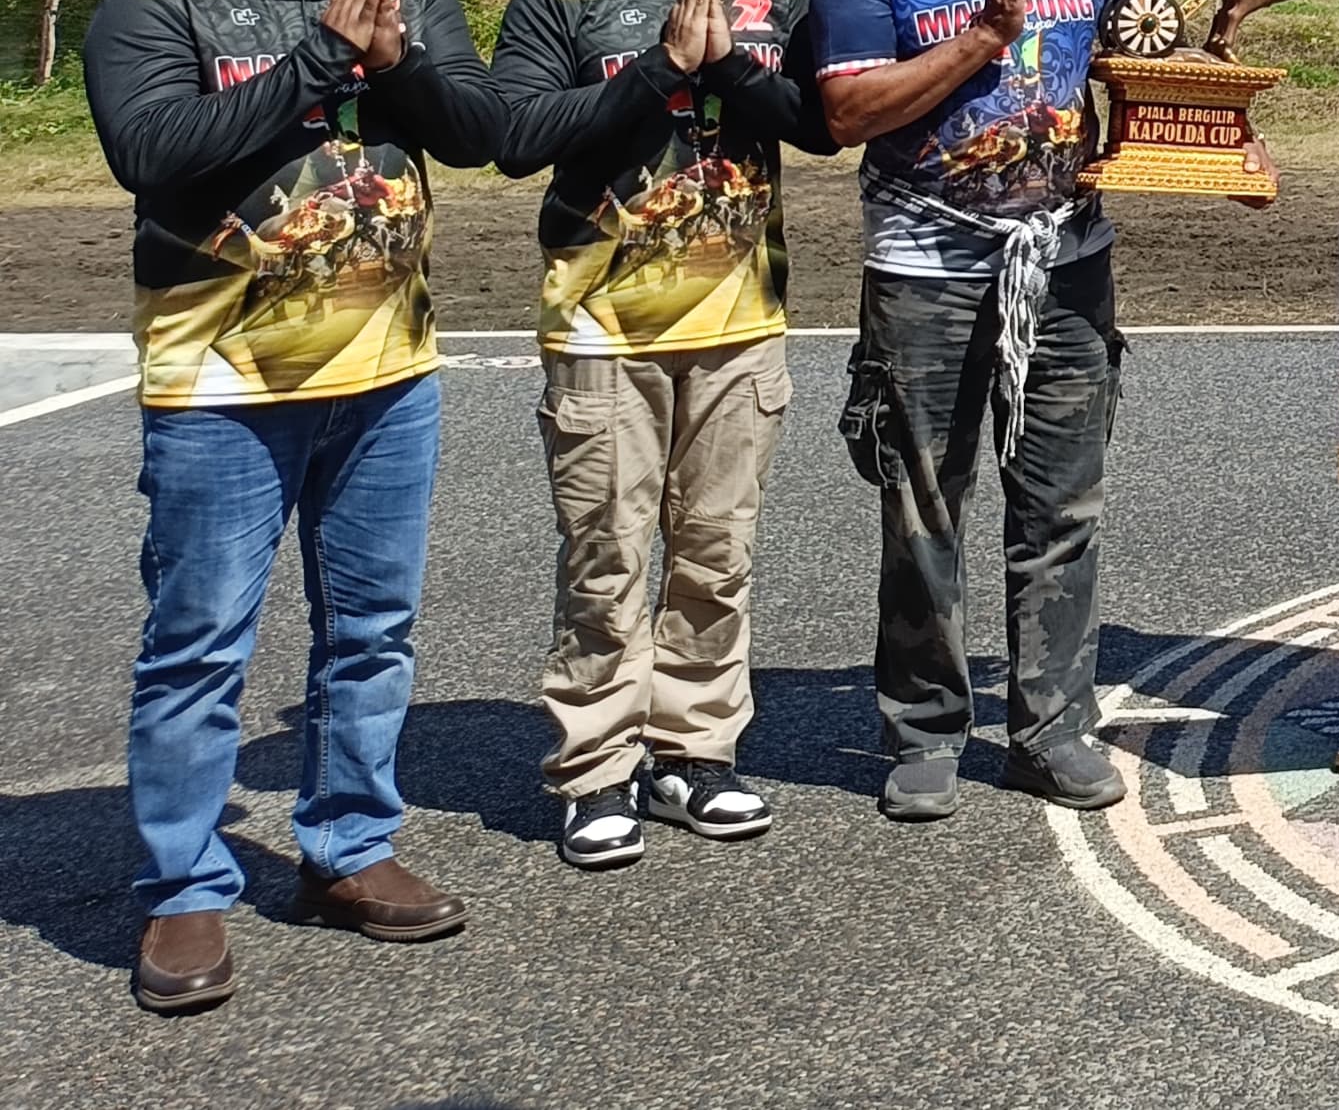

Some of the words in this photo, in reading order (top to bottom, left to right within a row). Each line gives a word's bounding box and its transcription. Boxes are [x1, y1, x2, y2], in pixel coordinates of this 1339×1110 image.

[1138, 105, 1174, 120] PIALA
[1178, 108, 1236, 124] BERGILIR
[1129, 121, 1206, 145] KAPOLDA
[1210, 126, 1242, 146] CUP
